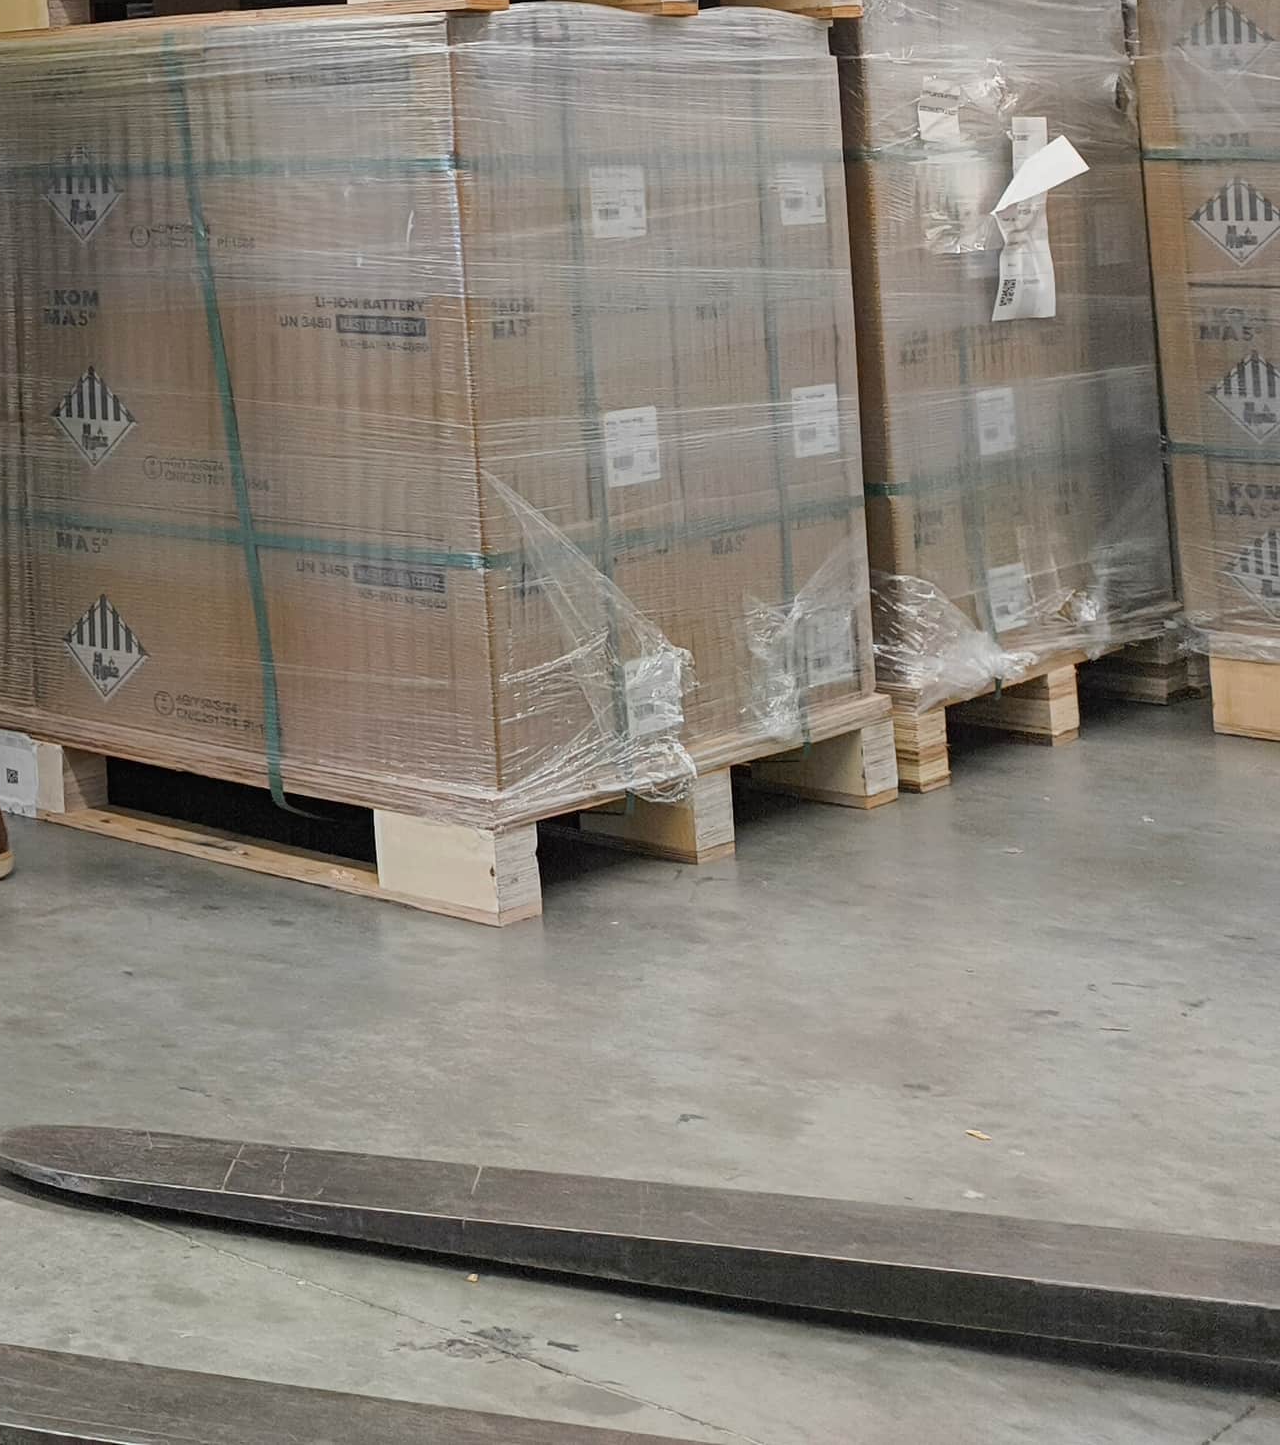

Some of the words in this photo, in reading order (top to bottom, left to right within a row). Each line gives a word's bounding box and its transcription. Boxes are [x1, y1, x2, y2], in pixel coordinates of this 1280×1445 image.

[315, 296, 360, 309] LI-ION
[362, 298, 426, 312] BATTERY
[43, 307, 97, 327] MA5°
[279, 317, 300, 328] UN
[55, 531, 109, 553] MA5°
